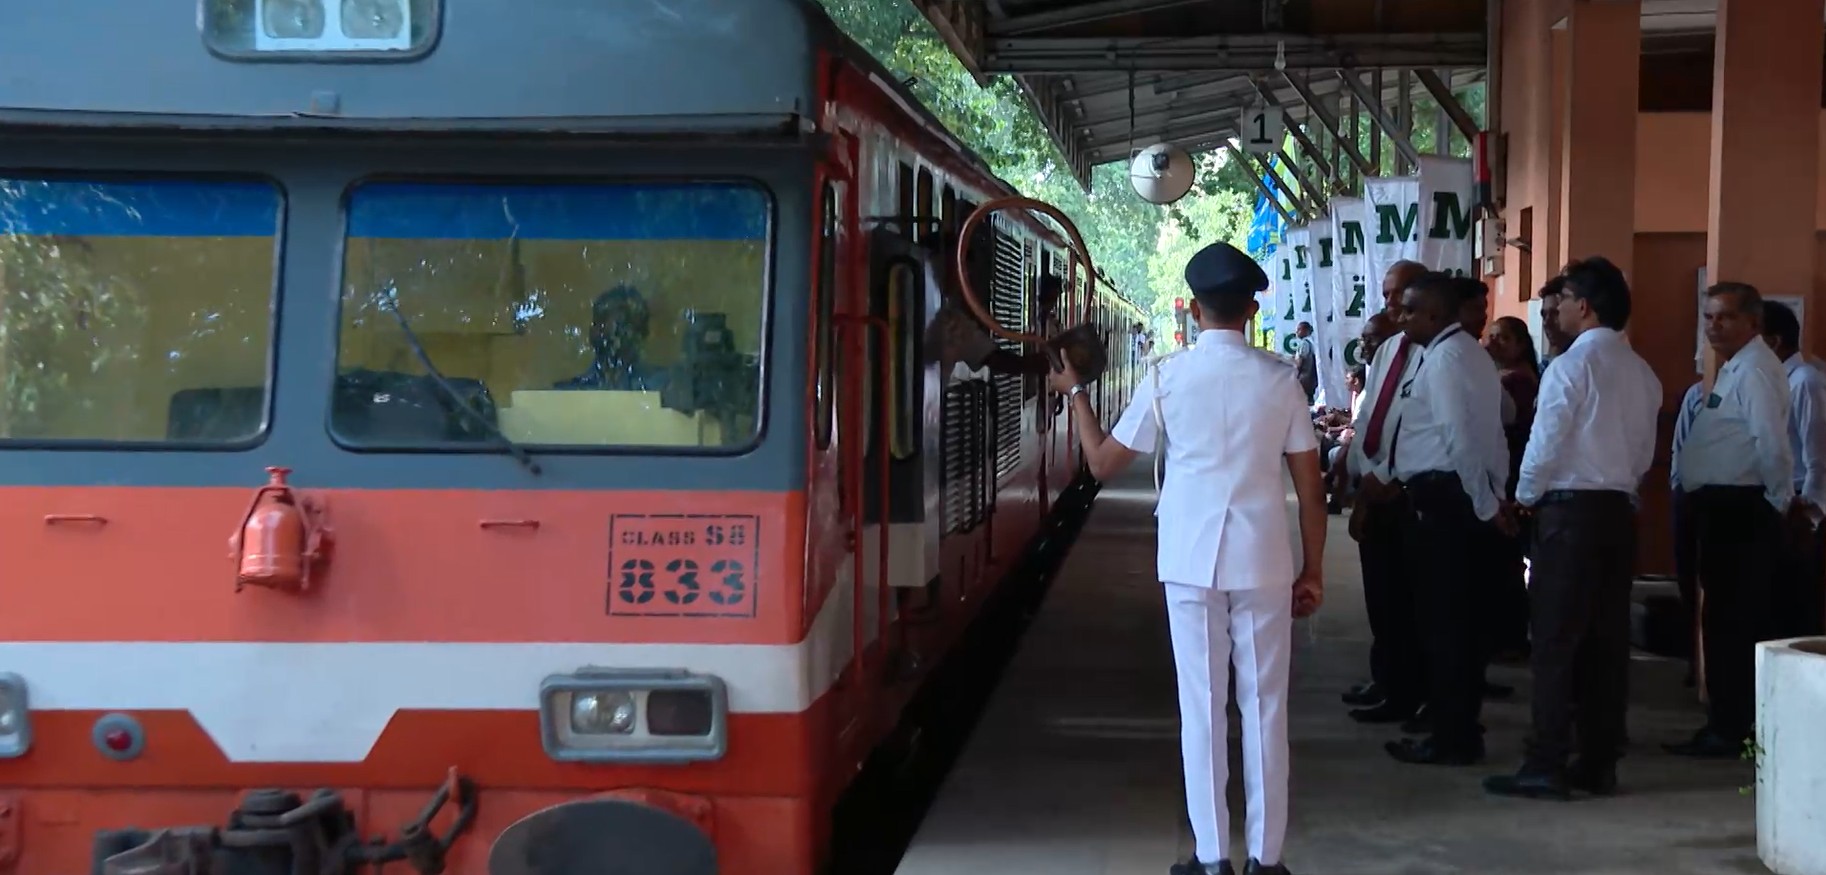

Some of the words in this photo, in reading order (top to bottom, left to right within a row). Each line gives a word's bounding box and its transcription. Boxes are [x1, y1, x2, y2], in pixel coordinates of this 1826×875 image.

[1250, 113, 1273, 144] 1
[622, 531, 696, 546] CLASS
[705, 524, 746, 546] S8
[618, 558, 746, 605] 833
